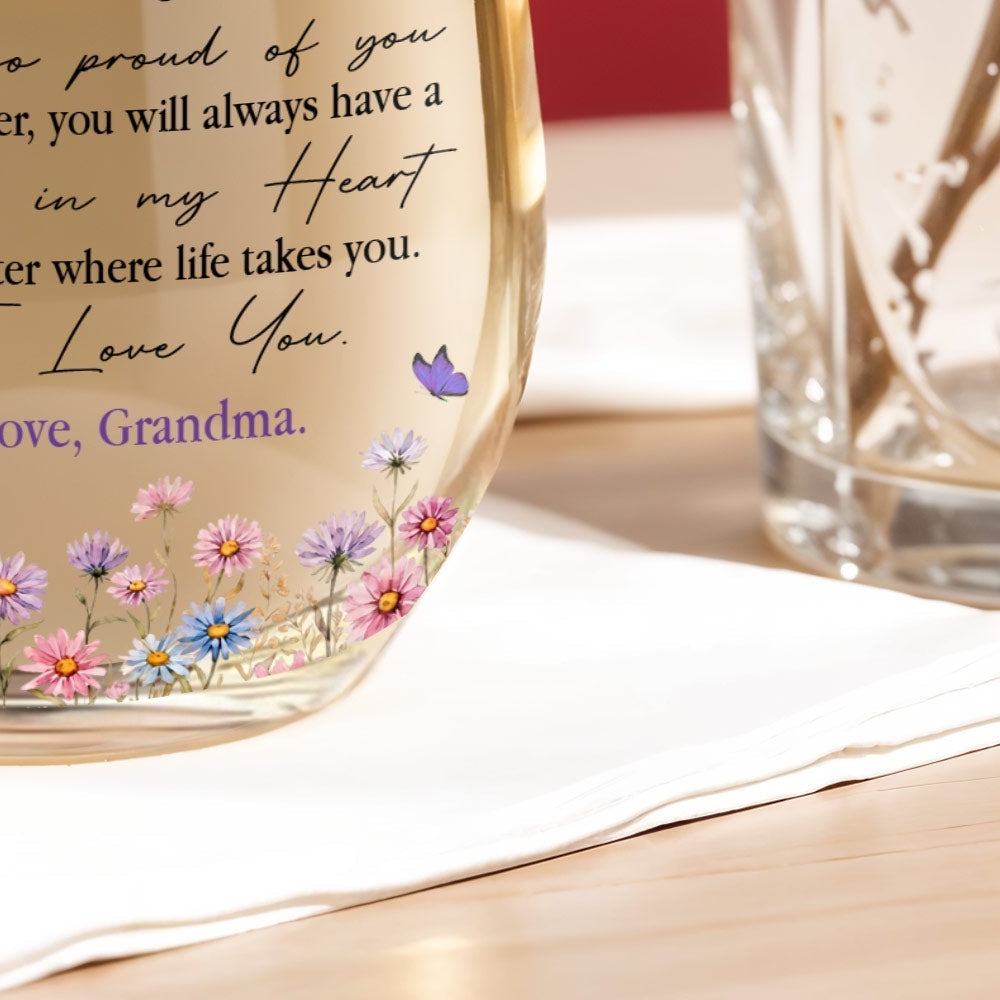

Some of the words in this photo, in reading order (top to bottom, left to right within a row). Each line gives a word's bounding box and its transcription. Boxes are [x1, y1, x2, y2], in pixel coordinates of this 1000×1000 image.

[64, 25, 228, 92] proud
[264, 18, 319, 78] of
[347, 27, 446, 72] you
[47, 110, 114, 148] you
[124, 94, 191, 134] will
[203, 92, 318, 135] always
[330, 82, 412, 119] have
[425, 82, 443, 107] a
[34, 186, 97, 211] in
[136, 190, 219, 227] my
[263, 134, 458, 225] Heart
[51, 247, 163, 285] where
[175, 241, 230, 281] life
[241, 236, 332, 276] takes
[343, 235, 421, 278] you.
[38, 304, 185, 376] Love
[229, 288, 349, 374] You.
[99, 398, 305, 447] Grandma.
